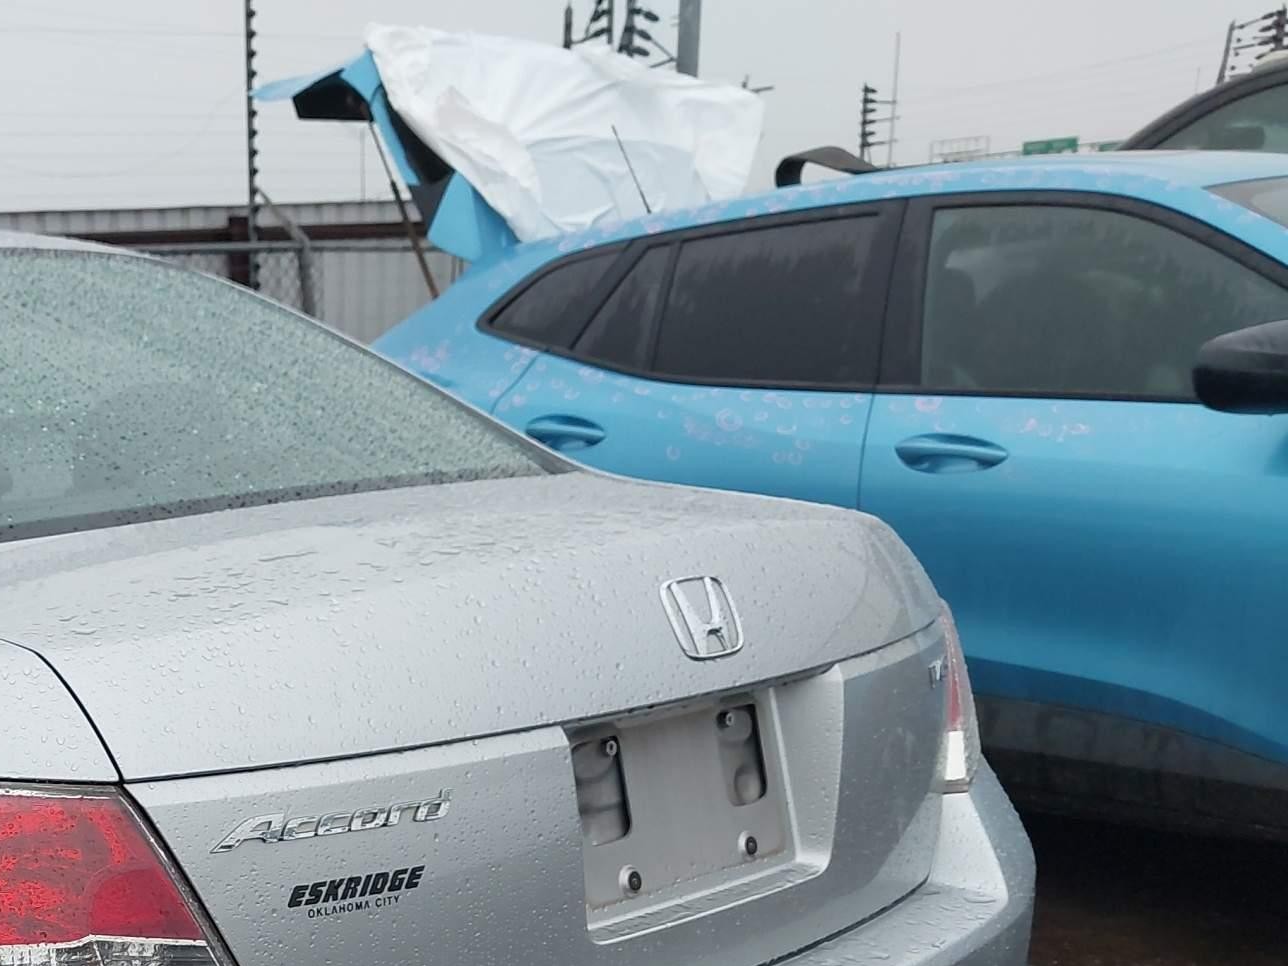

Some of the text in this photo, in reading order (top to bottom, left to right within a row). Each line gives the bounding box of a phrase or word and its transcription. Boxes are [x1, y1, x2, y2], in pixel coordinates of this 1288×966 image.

[210, 788, 453, 853] Accord
[287, 865, 425, 908] ESKRIDGE
[308, 895, 400, 918] OKLAHOMA CITY
